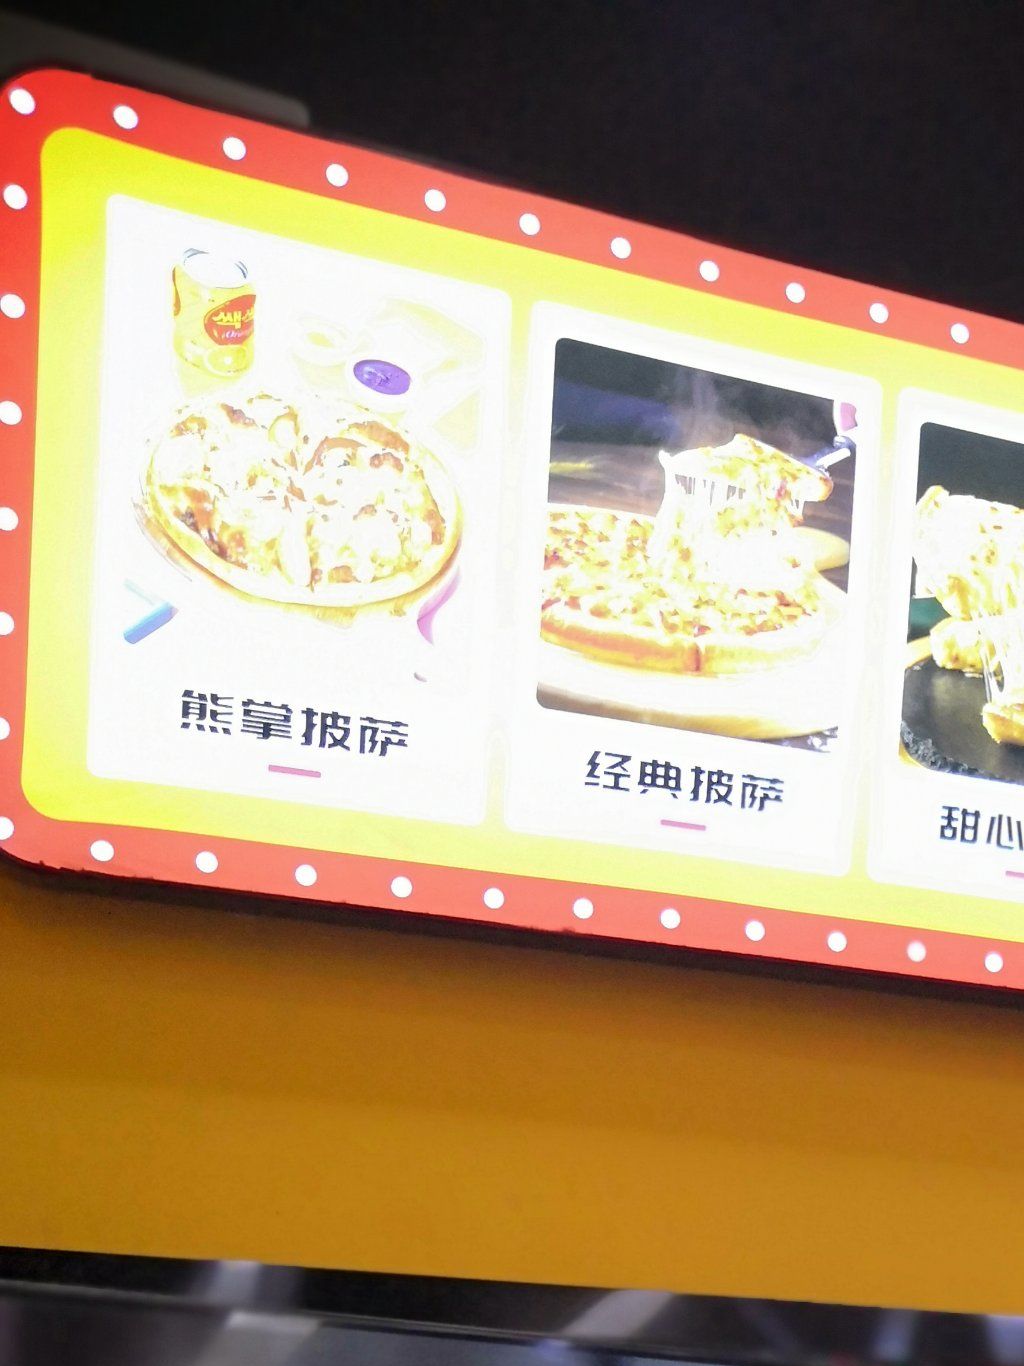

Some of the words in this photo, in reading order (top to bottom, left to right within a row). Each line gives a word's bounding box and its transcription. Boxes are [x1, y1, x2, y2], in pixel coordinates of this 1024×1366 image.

[180, 689, 409, 758] 熊掌披萨
[584, 750, 785, 812] 经典披萨
